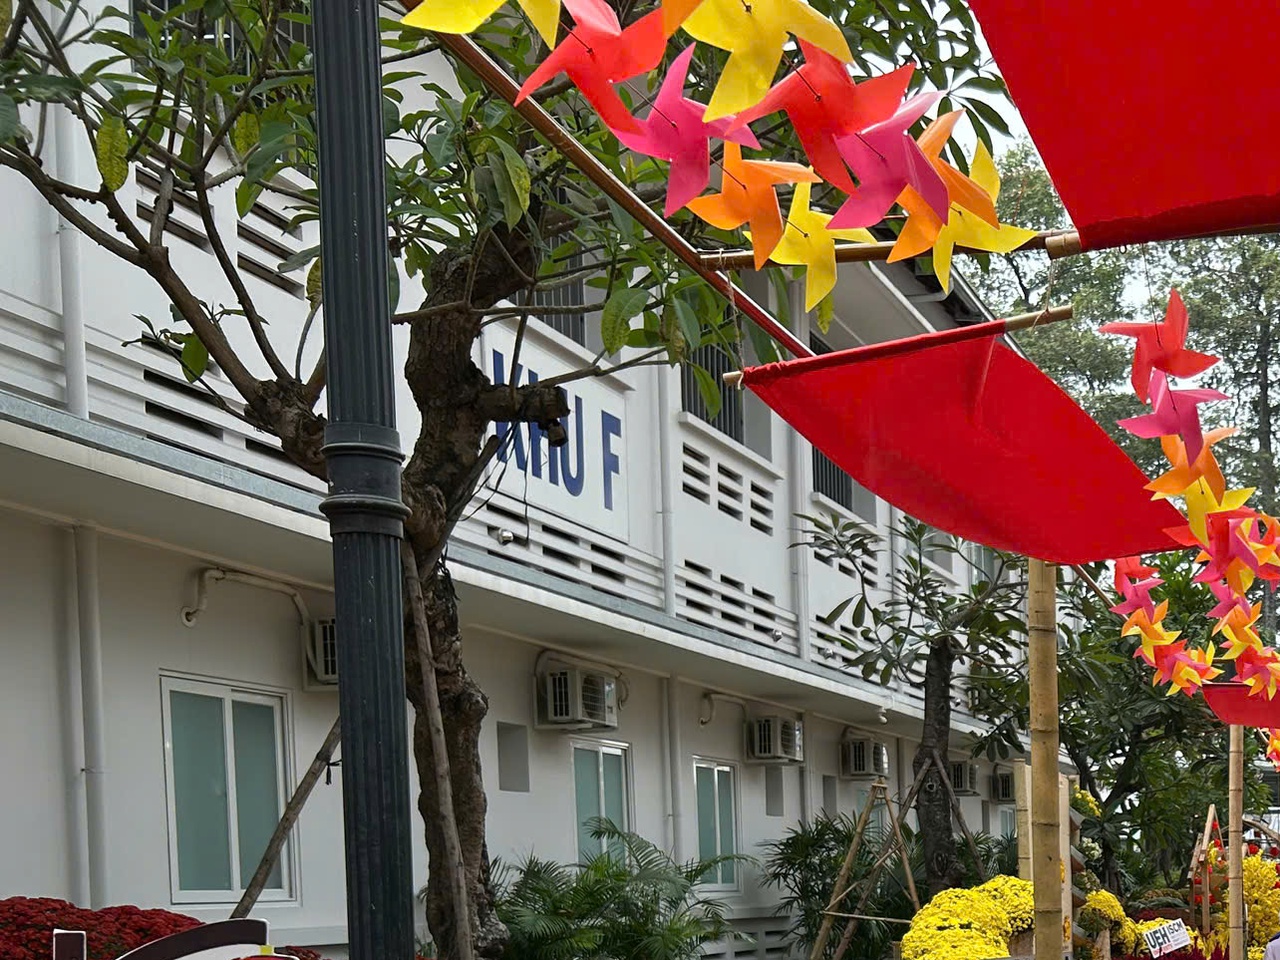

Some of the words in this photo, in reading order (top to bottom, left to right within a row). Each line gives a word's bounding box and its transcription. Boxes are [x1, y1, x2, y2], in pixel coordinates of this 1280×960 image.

[601, 410, 622, 511] F
[1145, 926, 1171, 949] UEH
[1166, 920, 1183, 935] ISCM
